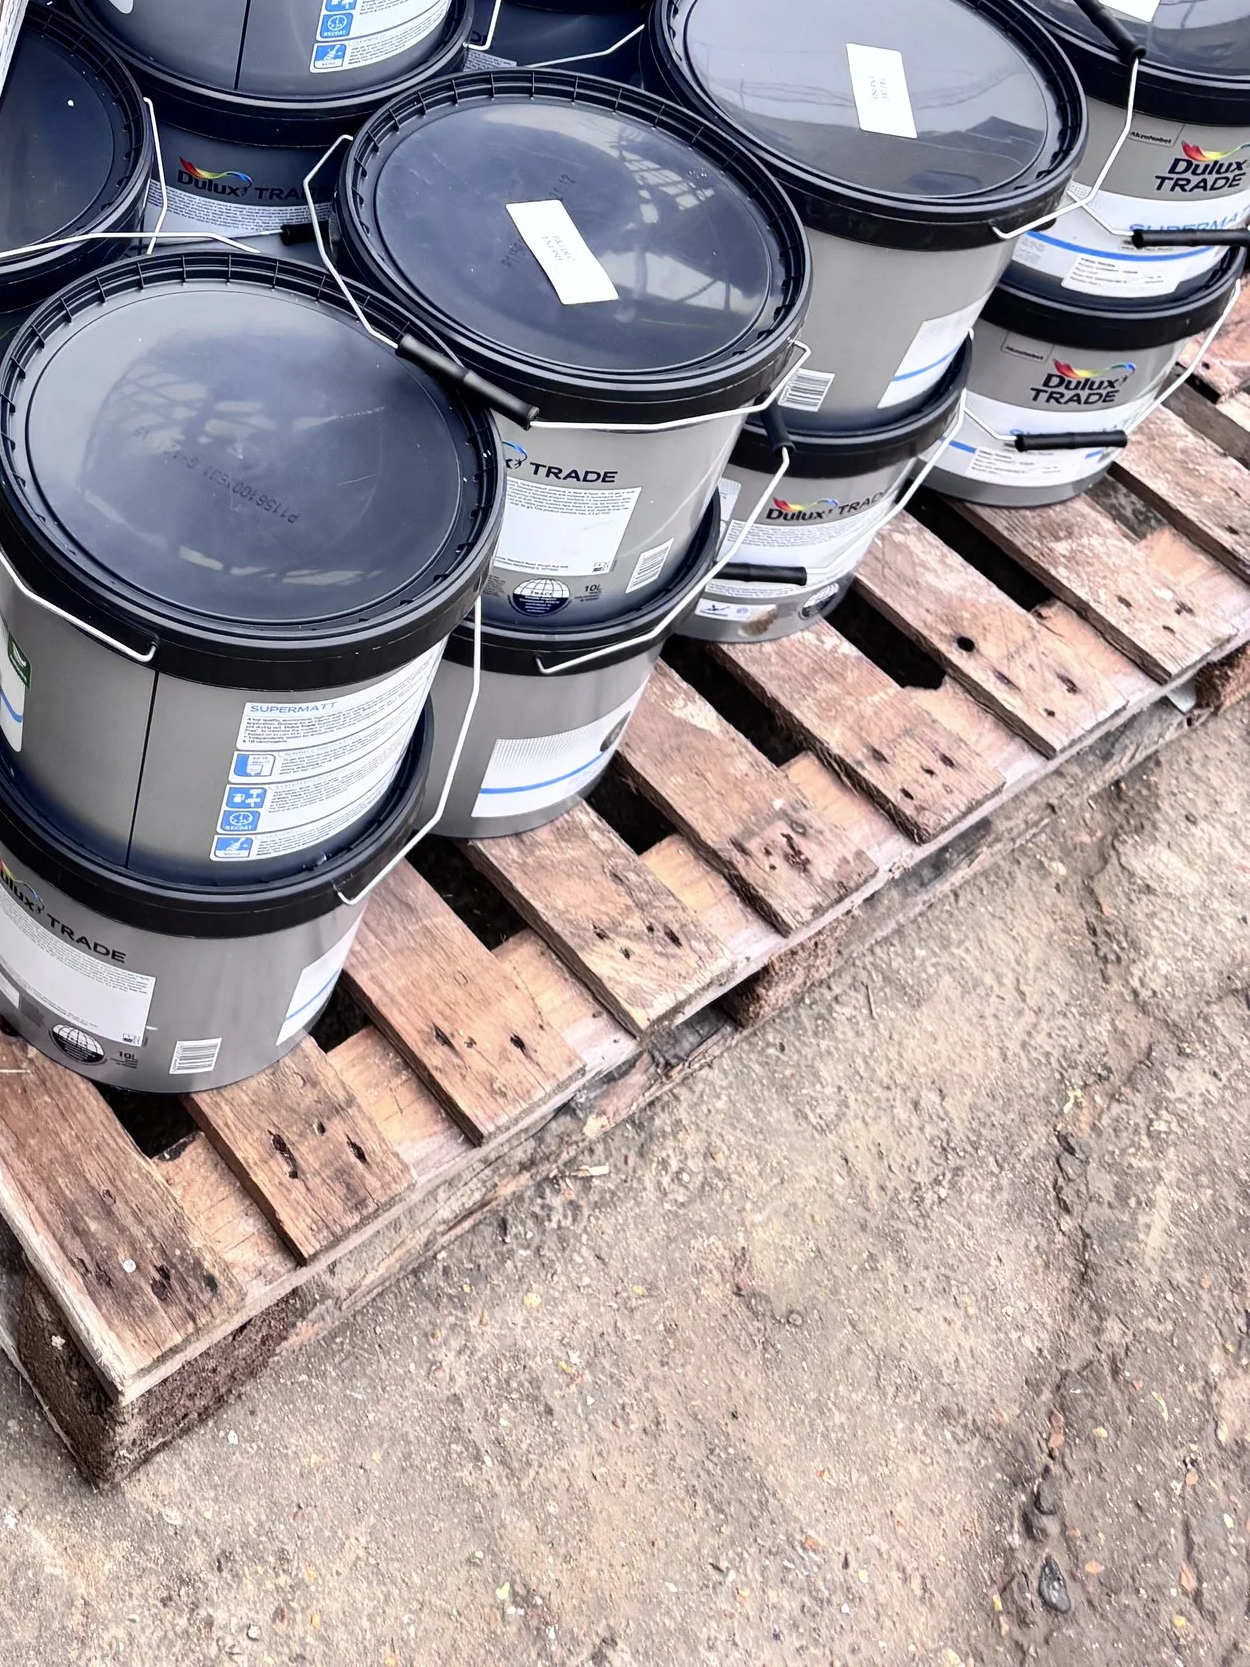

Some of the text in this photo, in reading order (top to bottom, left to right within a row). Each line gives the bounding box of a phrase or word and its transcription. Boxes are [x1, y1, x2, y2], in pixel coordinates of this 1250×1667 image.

[1168, 156, 1247, 176] Dulux
[176, 170, 240, 197] Dulux
[1154, 171, 1247, 192] TRADE
[1041, 373, 1119, 391] Dulux
[1030, 387, 1121, 406] TRADE
[529, 461, 619, 484] TRADE
[766, 507, 825, 522] Dulux
[250, 702, 339, 714] SUPERMATT
[46, 912, 127, 965] TRADE
